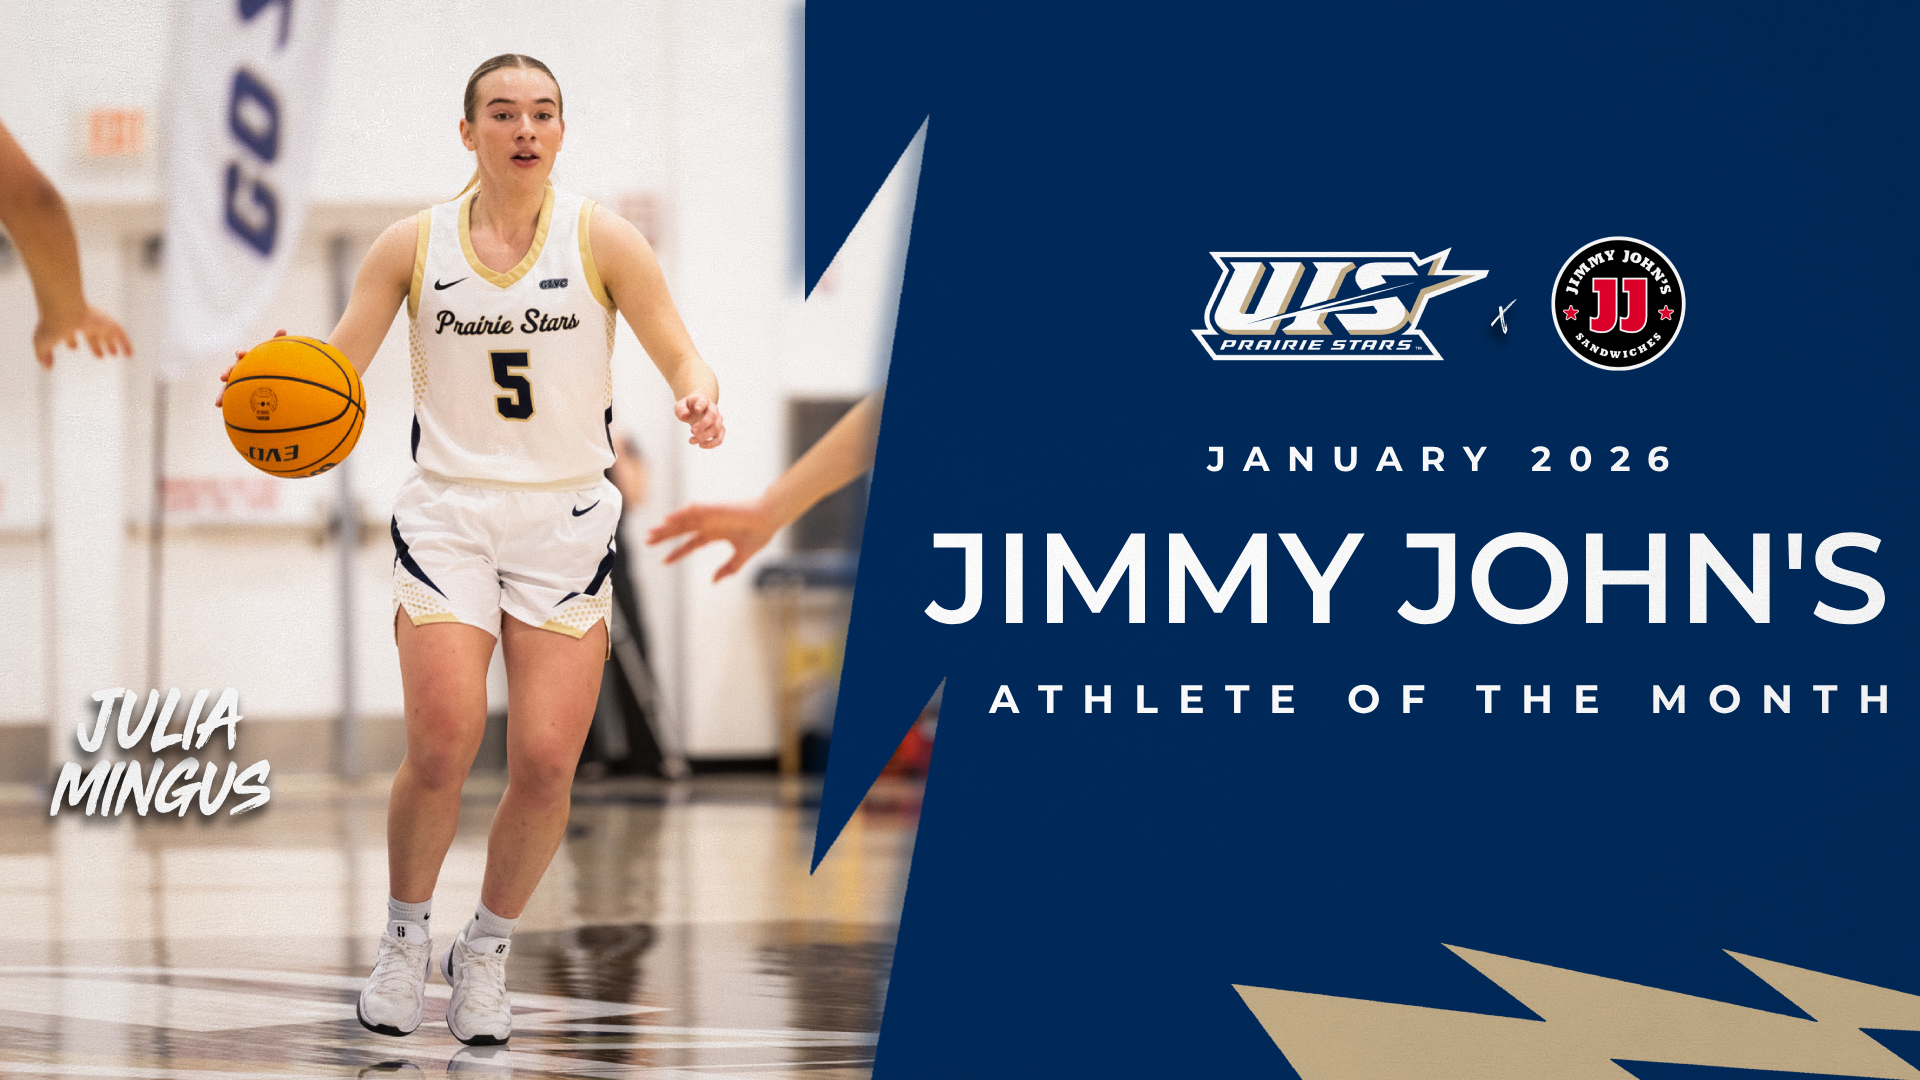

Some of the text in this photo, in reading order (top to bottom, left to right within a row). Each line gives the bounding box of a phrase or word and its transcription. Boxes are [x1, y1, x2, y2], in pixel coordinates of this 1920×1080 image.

[225, 66, 279, 257] GO
[435, 307, 580, 335] Prairie Stars
[488, 349, 536, 422] 5
